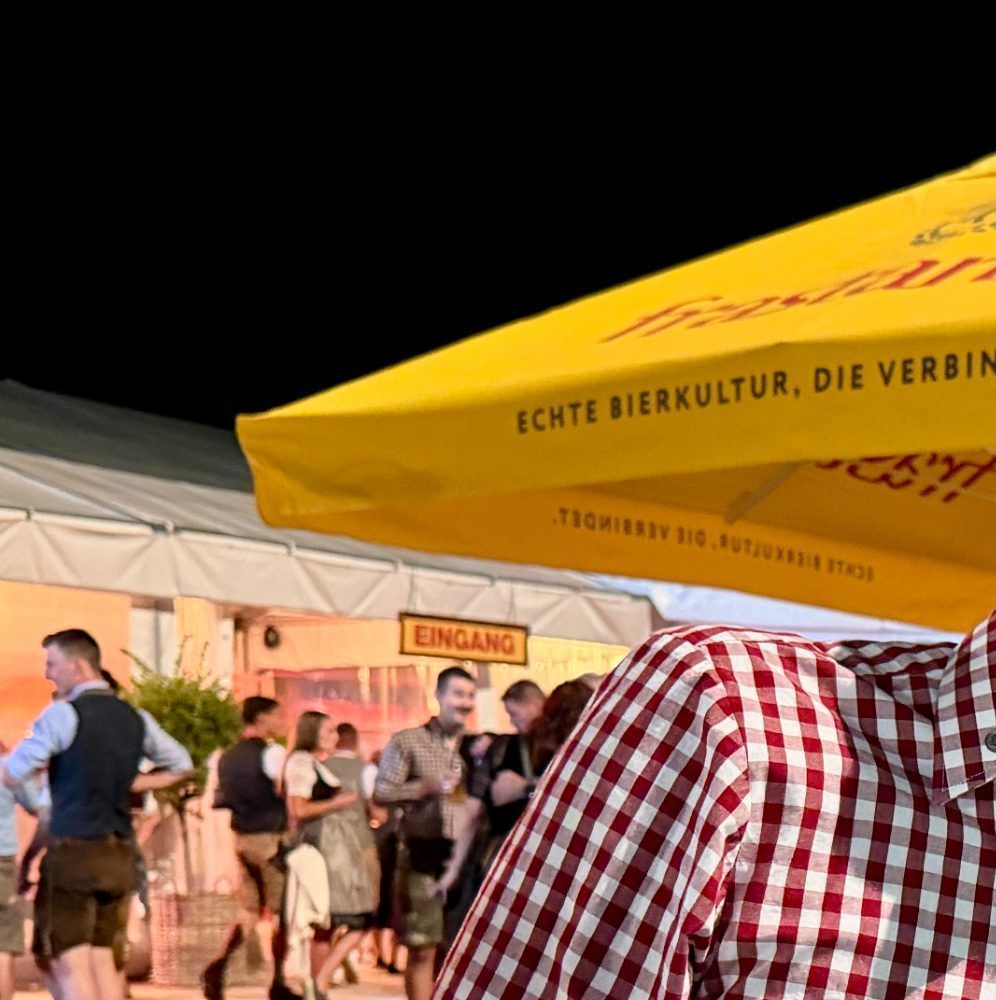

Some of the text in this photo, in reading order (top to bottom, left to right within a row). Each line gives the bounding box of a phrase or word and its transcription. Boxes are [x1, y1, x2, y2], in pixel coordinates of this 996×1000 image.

[517, 400, 598, 434] ECHTE
[610, 371, 800, 419] BIERKULTUR,
[814, 364, 863, 393] DIE
[414, 624, 515, 655] EINGANG
